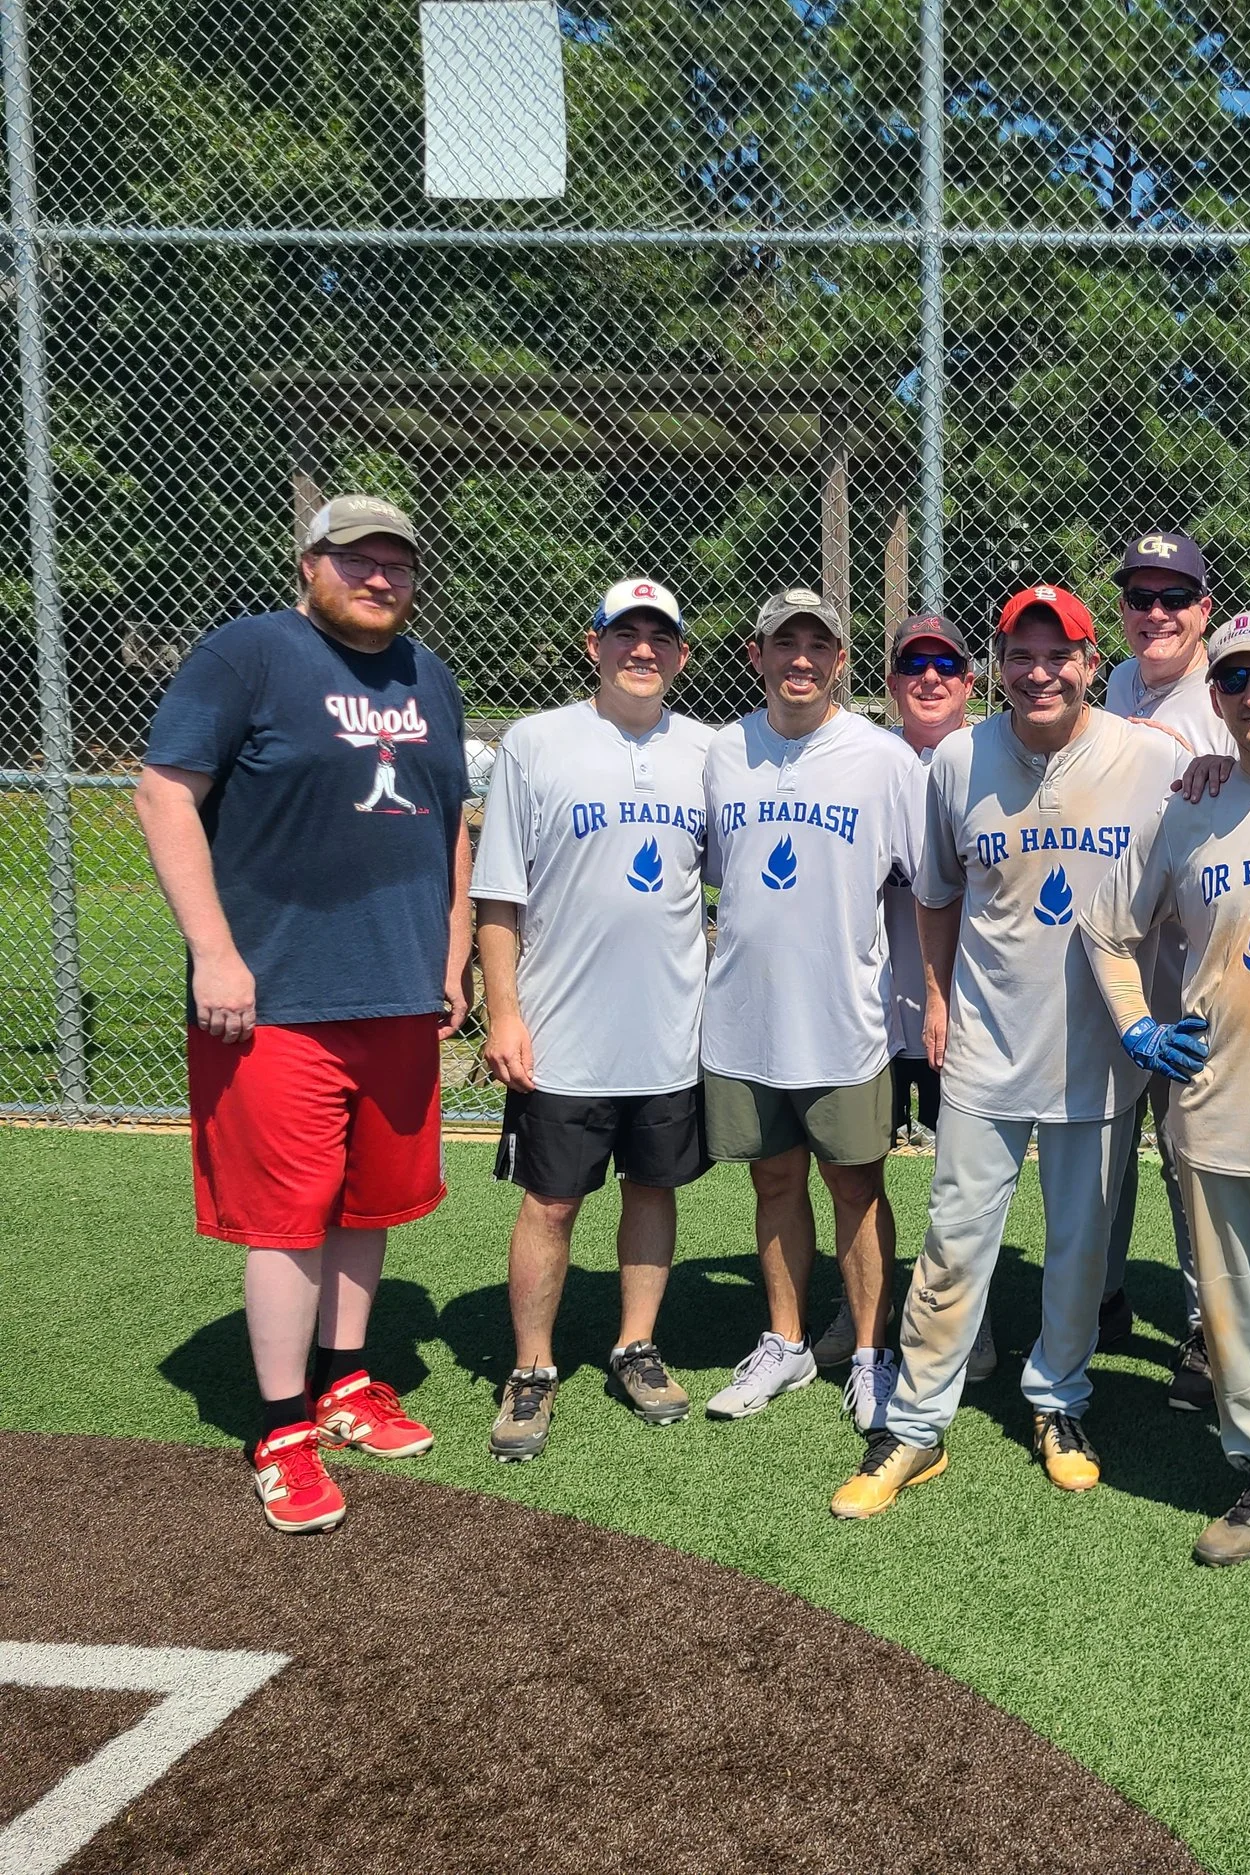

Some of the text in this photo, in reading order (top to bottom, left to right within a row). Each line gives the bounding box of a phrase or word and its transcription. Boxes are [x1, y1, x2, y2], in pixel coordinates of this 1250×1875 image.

[1138, 535, 1178, 559] GT
[324, 694, 429, 739] Wood
[572, 802, 608, 840] OR
[721, 801, 859, 845] OR HADASH
[977, 826, 1131, 867] OR HADASH
[1201, 864, 1231, 906] OR
